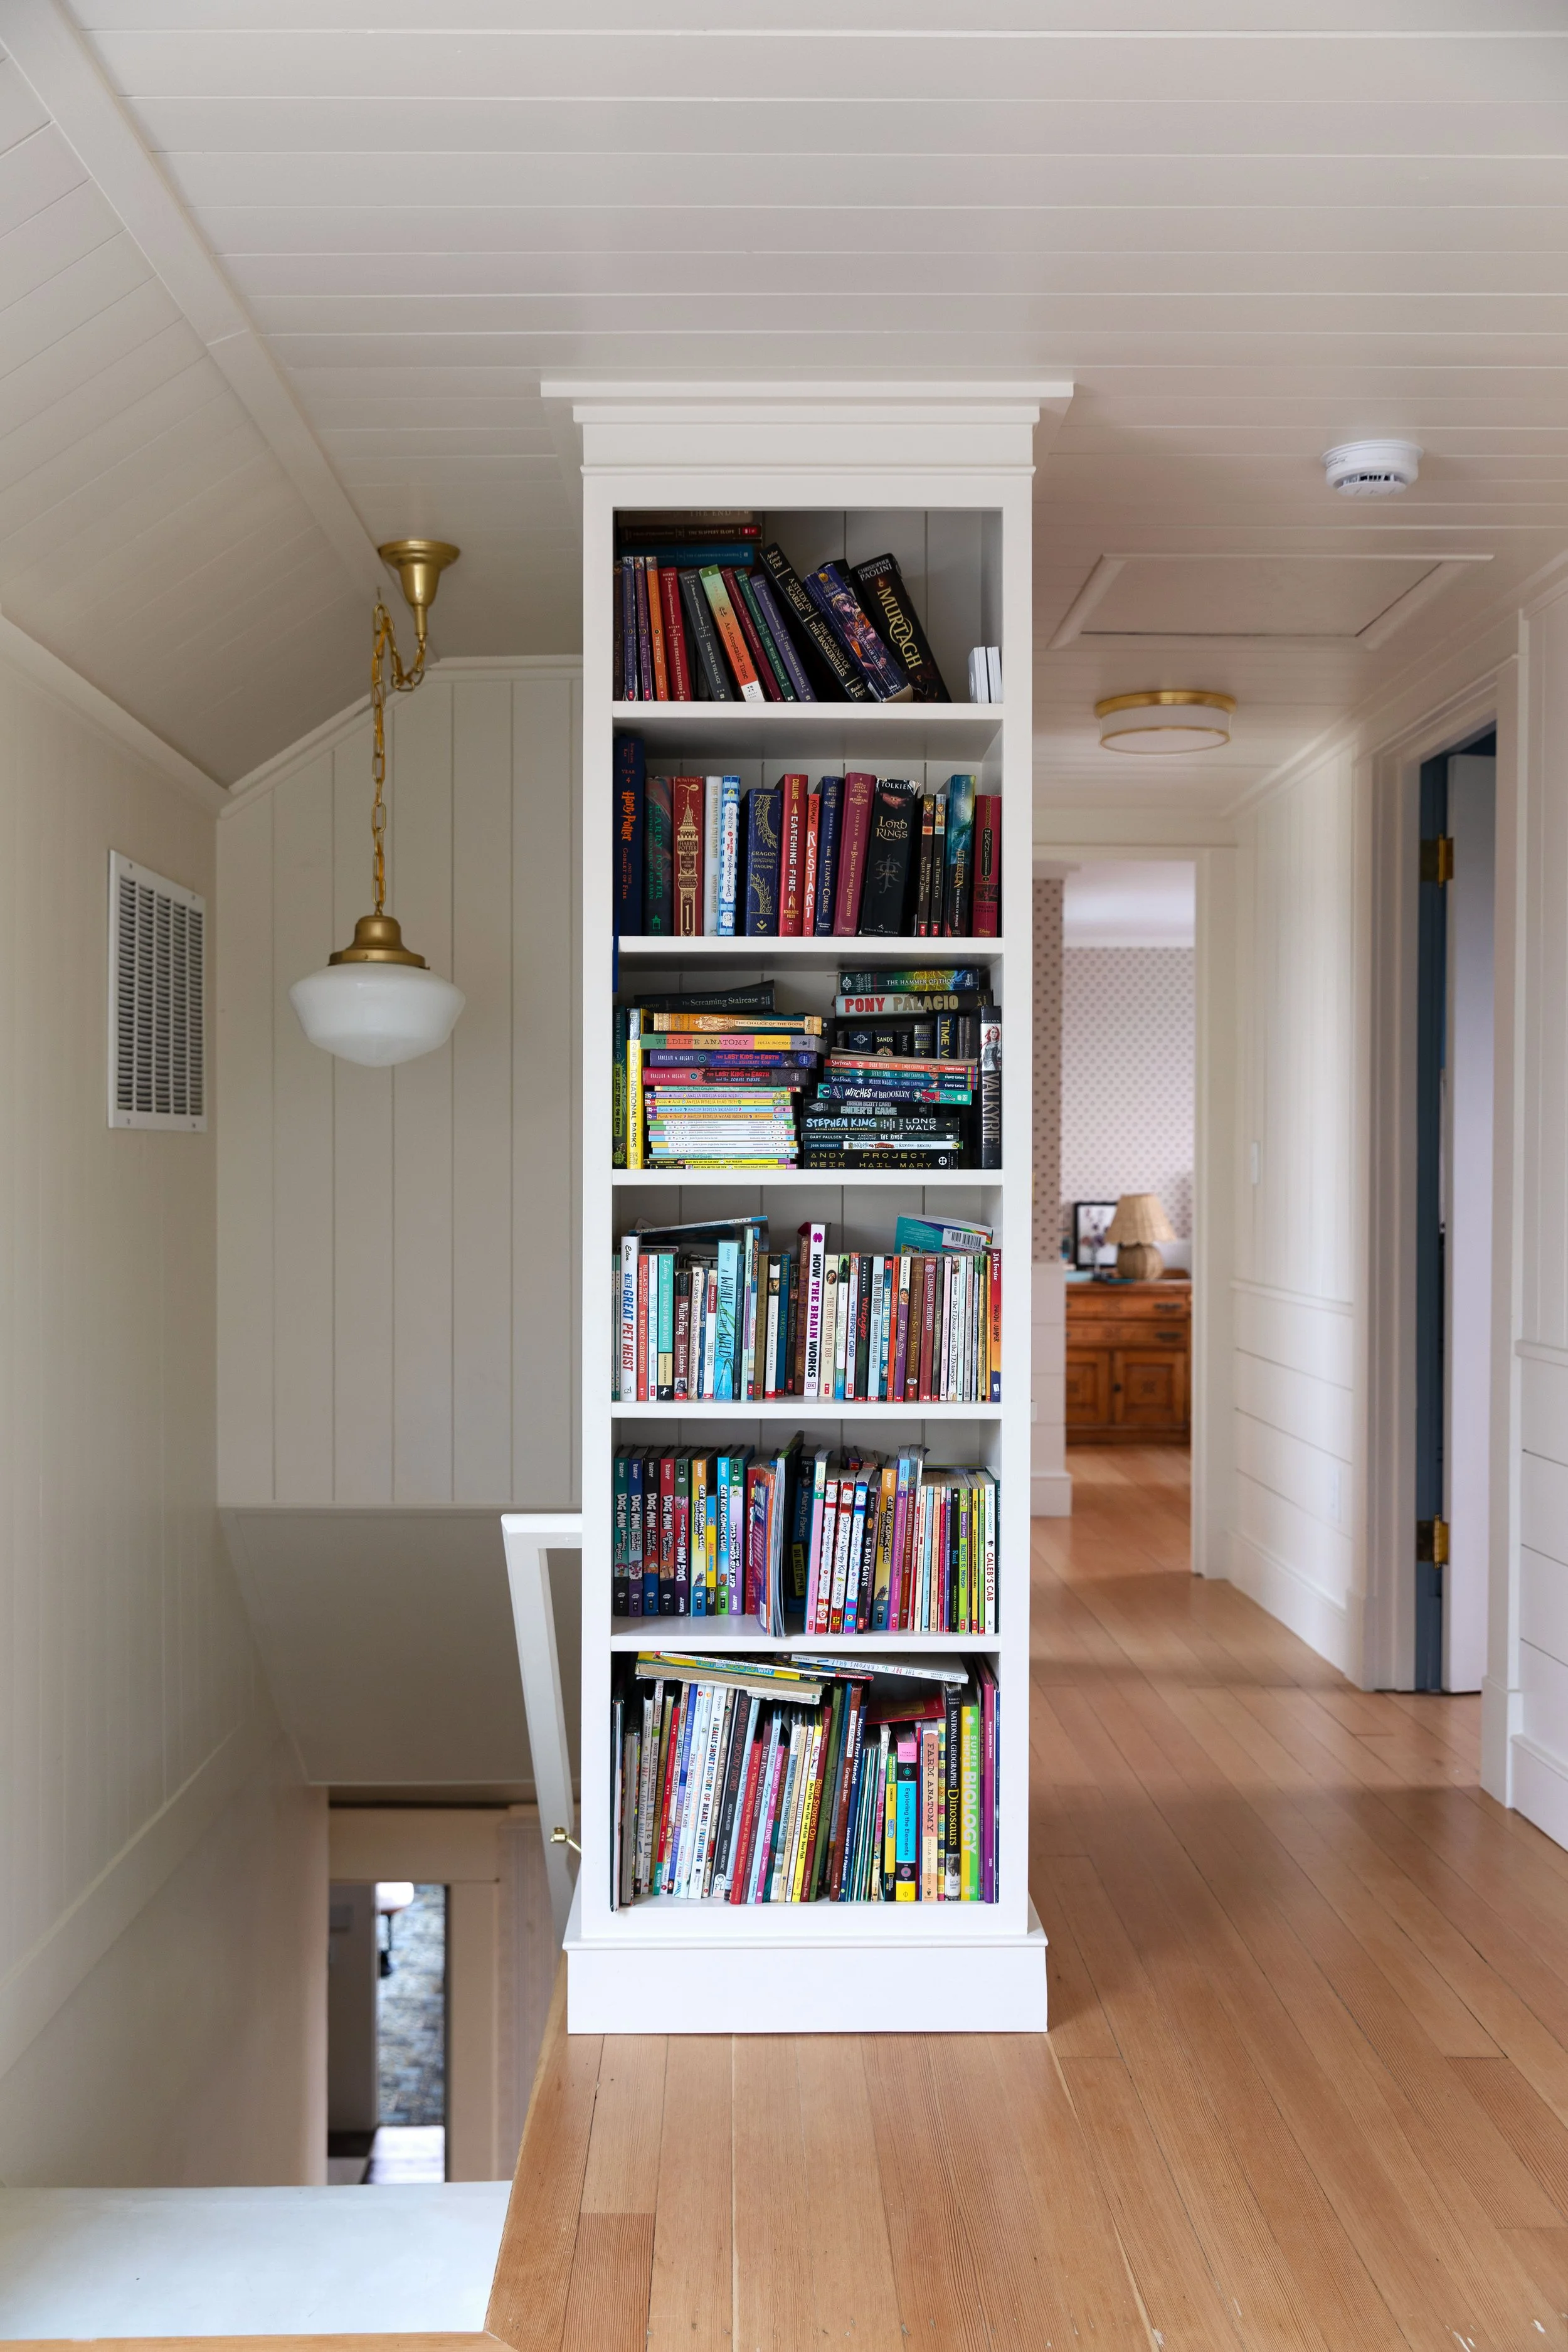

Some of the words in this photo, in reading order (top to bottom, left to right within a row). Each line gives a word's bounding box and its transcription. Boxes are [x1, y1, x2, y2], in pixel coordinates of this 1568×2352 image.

[860, 563, 893, 581] PAOLINI
[785, 585, 807, 612] SCARLET
[792, 582, 808, 603] STUDY
[805, 603, 814, 613] IN
[877, 586, 923, 669] MURTAGH
[724, 622, 730, 631] An
[728, 632, 744, 663] Acceptable
[739, 662, 748, 679] Time
[809, 621, 821, 636] THE
[817, 635, 847, 677] BASKERVILLES
[818, 622, 829, 636] THE
[825, 635, 845, 661] HOUND
[842, 660, 851, 669] OF
[881, 781, 912, 791] TOLKIEN
[621, 792, 635, 814] Harry
[810, 798, 818, 825] KORMAN
[621, 815, 635, 840] Potter
[879, 816, 908, 829] LORD
[789, 816, 798, 865] CATCHING
[876, 827, 908, 841] RINGS
[805, 830, 817, 919] RESTART
[822, 888, 830, 913] CURSE
[691, 998, 727, 1007] Screaming
[845, 997, 886, 1013] PONY
[893, 994, 958, 1012] PALACIO
[630, 1068, 637, 1079] TO
[845, 1088, 872, 1098] WITCHES
[878, 1090, 910, 1099] BROOKLYN
[840, 1106, 872, 1115] ENDER'S
[874, 1106, 897, 1115] GAME
[982, 1073, 1000, 1145] VALKYRIE
[806, 1118, 847, 1127] STEPHEN
[851, 1118, 877, 1127] KING
[812, 1254, 821, 1278] HOW
[720, 1276, 733, 1304] WHALE
[810, 1281, 820, 1302] THE
[622, 1290, 633, 1320] GREAT
[678, 1302, 688, 1320] White
[622, 1322, 633, 1341] PET
[675, 1322, 687, 1335] Fang
[809, 1305, 818, 1338] BRAIN
[677, 1344, 685, 1354] Jack
[718, 1333, 732, 1357] WILD
[825, 1333, 833, 1346] ONLY
[895, 1342, 904, 1357] Story
[622, 1343, 633, 1371] HEIST
[807, 1341, 817, 1378] WORKS
[824, 1347, 832, 1358] BOB
[617, 1493, 627, 1510] DOG
[646, 1493, 657, 1510] DOG
[617, 1512, 627, 1528] MAN
[646, 1511, 656, 1528] MAN
[678, 1547, 687, 1564] MAN
[864, 1548, 872, 1564] BAD
[677, 1564, 687, 1582] DOG
[861, 1565, 870, 1587] GUYS
[711, 1724, 719, 1744] REALLY
[708, 1744, 717, 1766] SHORT
[761, 1745, 770, 1760] THE
[704, 1766, 714, 1791] HISTORY
[758, 1761, 767, 1784] POLAR
[703, 1793, 711, 1801] OF
[813, 1779, 823, 1798] Bear
[753, 1786, 763, 1817] EXPRESS
[701, 1803, 709, 1825] NEARLY
[810, 1799, 820, 1827] Snores
[948, 1789, 958, 1845] Dinosaurs
[962, 1771, 977, 1855] BIOLOGY
[696, 1828, 706, 1862] EVERYTHING
[808, 1828, 816, 1841] On
